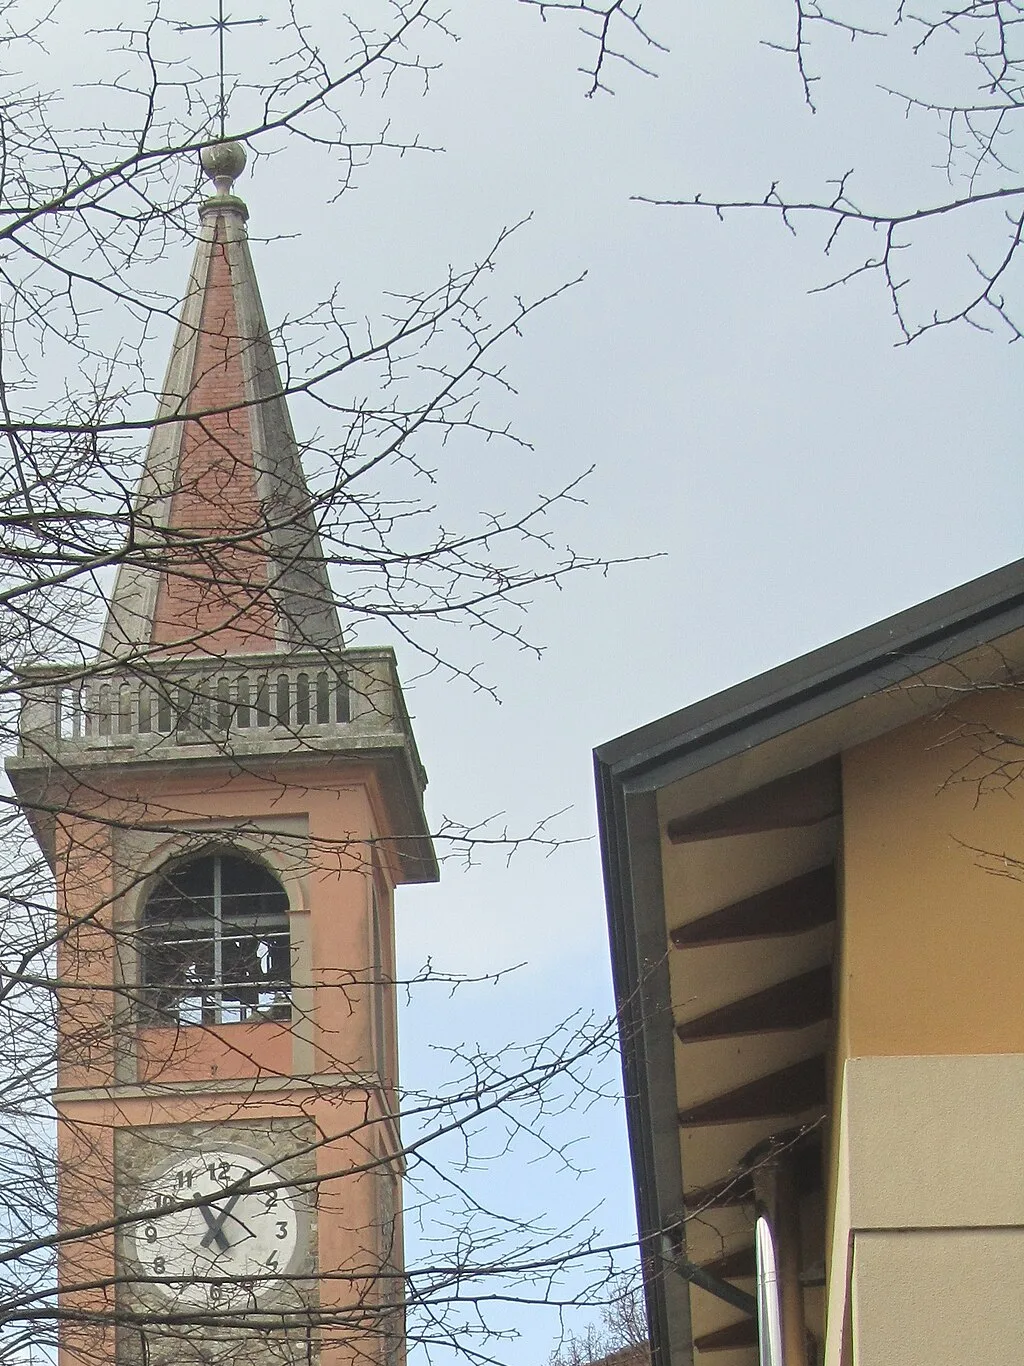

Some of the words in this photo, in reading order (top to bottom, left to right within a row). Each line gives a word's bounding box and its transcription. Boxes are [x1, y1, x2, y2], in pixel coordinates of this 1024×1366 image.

[176, 1170, 193, 1189] 11
[208, 1162, 230, 1181] 12
[145, 1226, 158, 1243] 9
[276, 1221, 288, 1240] 3
[154, 1256, 165, 1274] 8
[265, 1250, 278, 1271] 4
